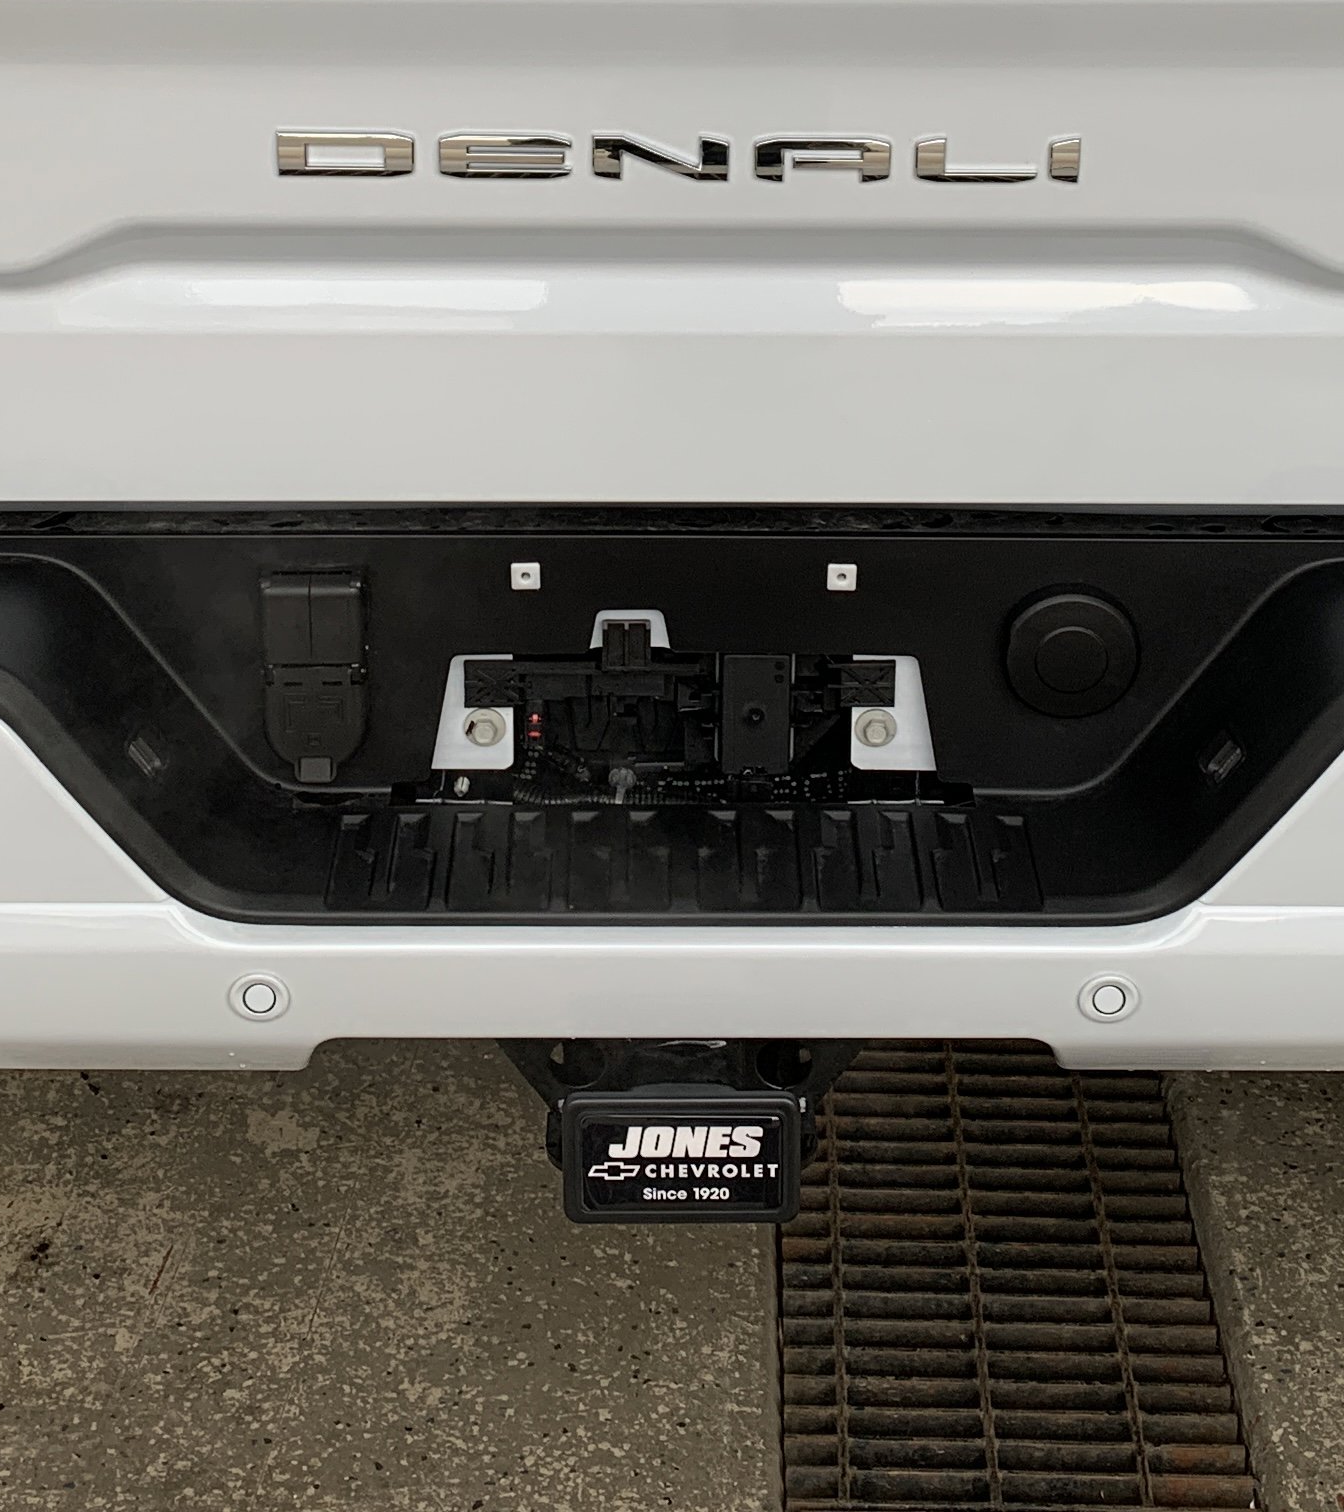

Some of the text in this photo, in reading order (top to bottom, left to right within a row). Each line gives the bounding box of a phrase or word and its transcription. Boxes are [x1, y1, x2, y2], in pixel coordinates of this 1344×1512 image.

[274, 129, 1082, 182] DENALI
[608, 1125, 764, 1159] JONES
[644, 1163, 779, 1179] CHEVROLET
[642, 1187, 730, 1201] Since 1920
